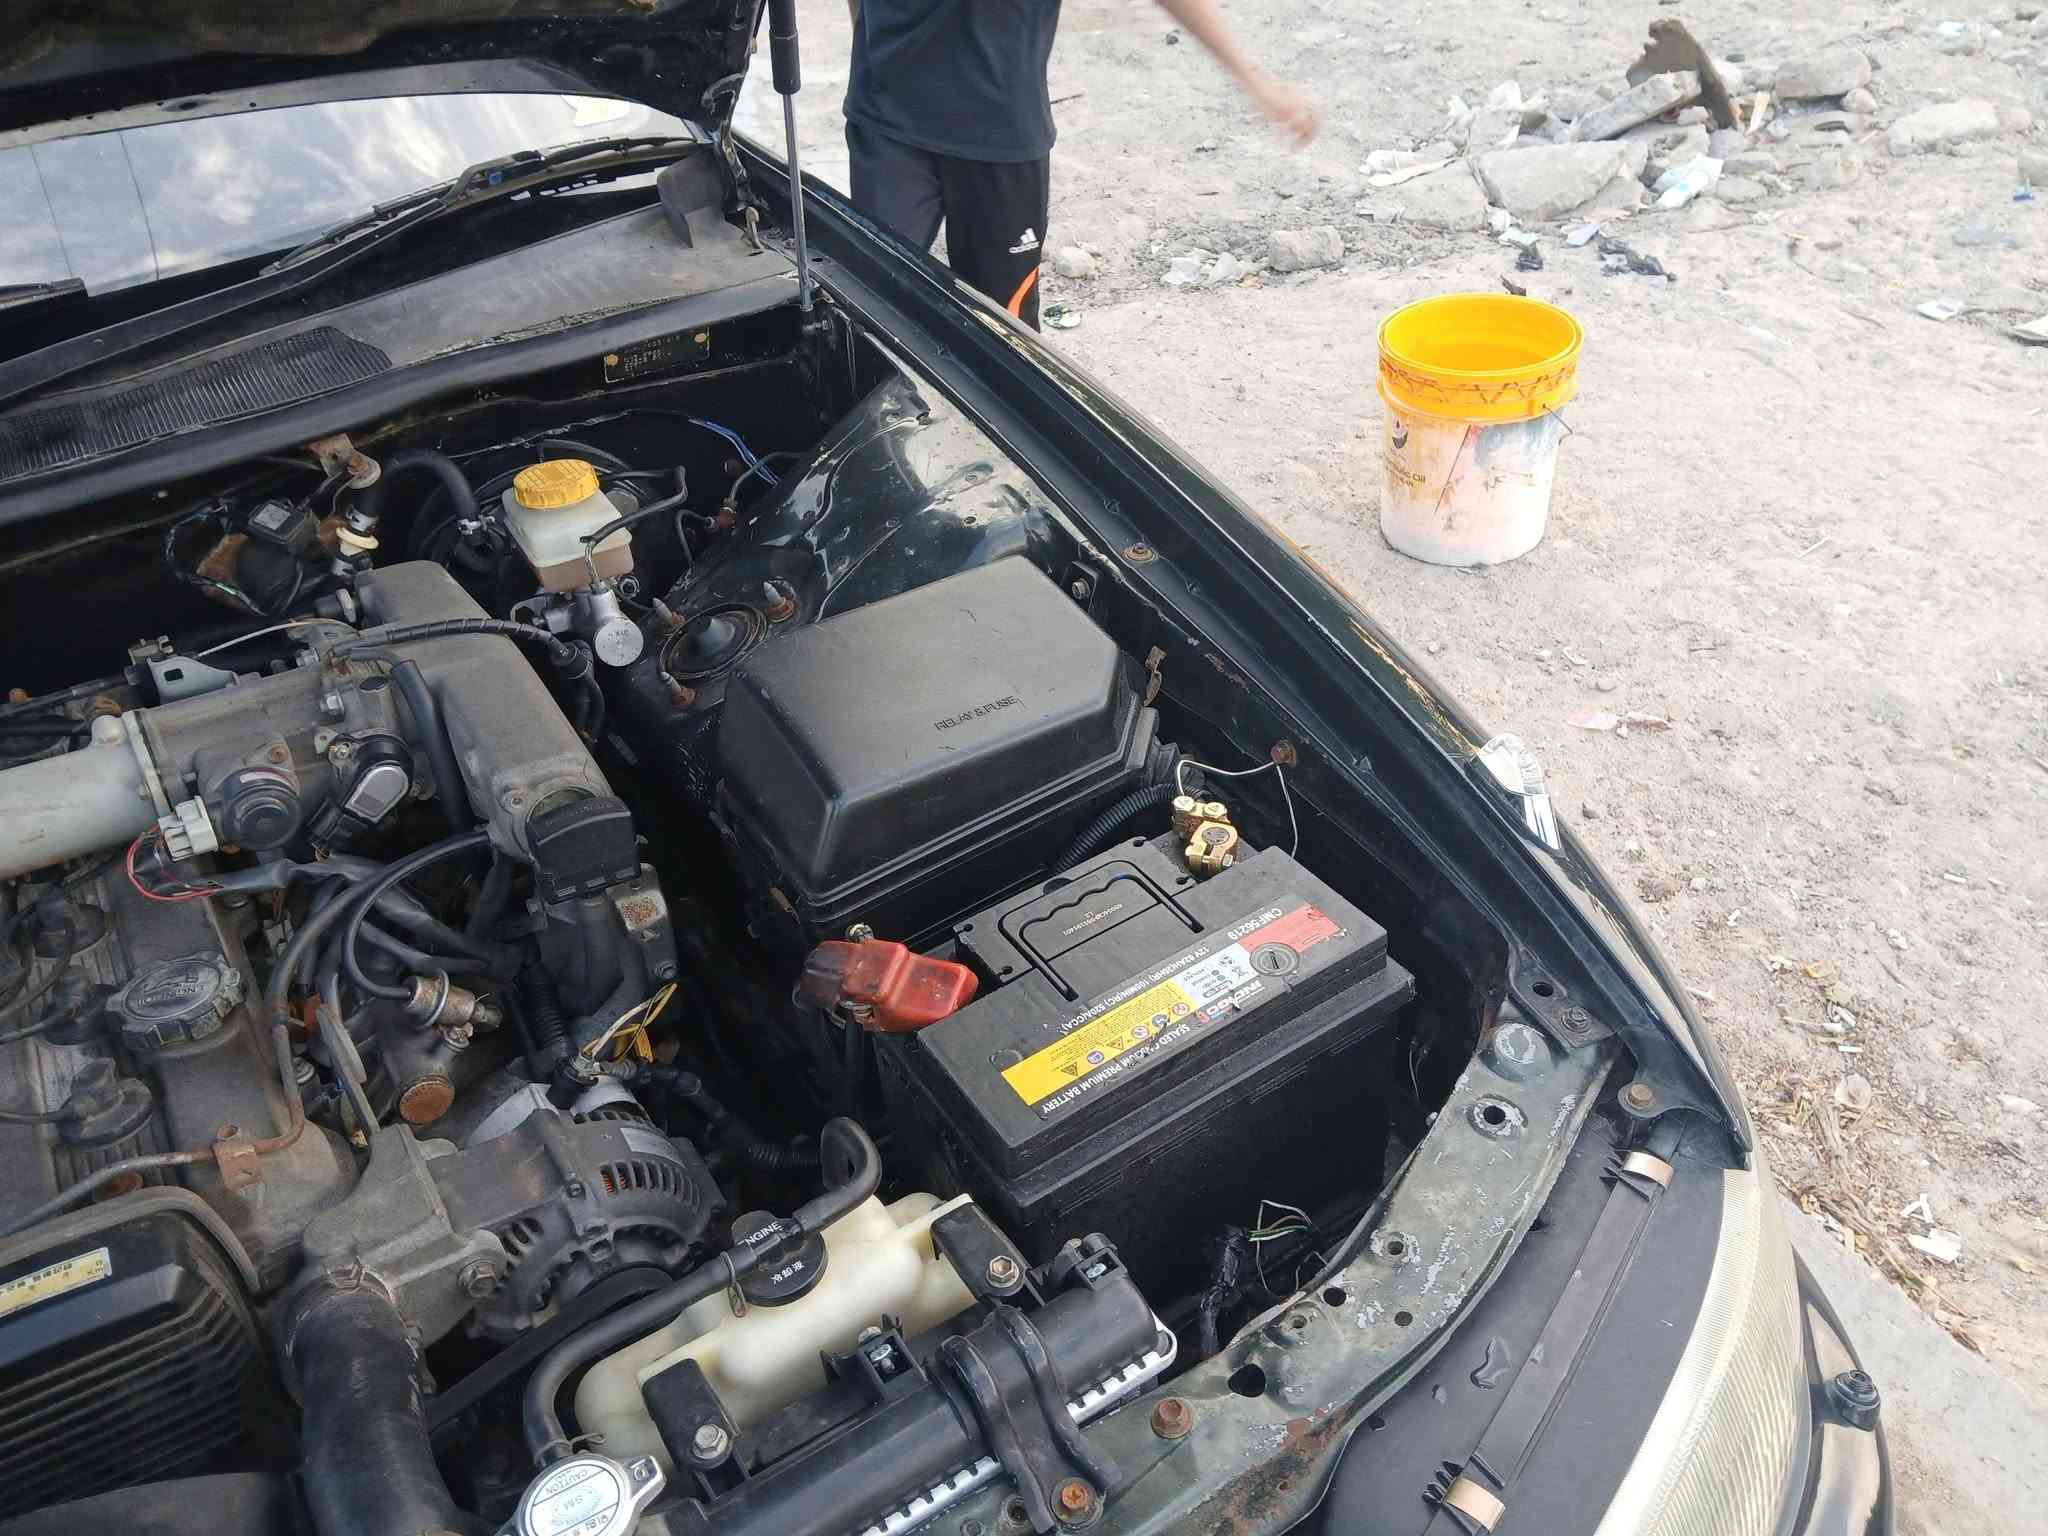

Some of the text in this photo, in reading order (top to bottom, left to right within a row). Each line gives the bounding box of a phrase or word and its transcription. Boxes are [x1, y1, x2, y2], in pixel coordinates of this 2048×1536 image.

[934, 711, 972, 730] RELAY
[983, 696, 1017, 712] FUSE
[1158, 1022, 1190, 1046] SEALED
[1079, 1061, 1122, 1092] PREMIUM
[1040, 1085, 1081, 1114] BATTERY
[545, 1469, 588, 1495] CAUTION
